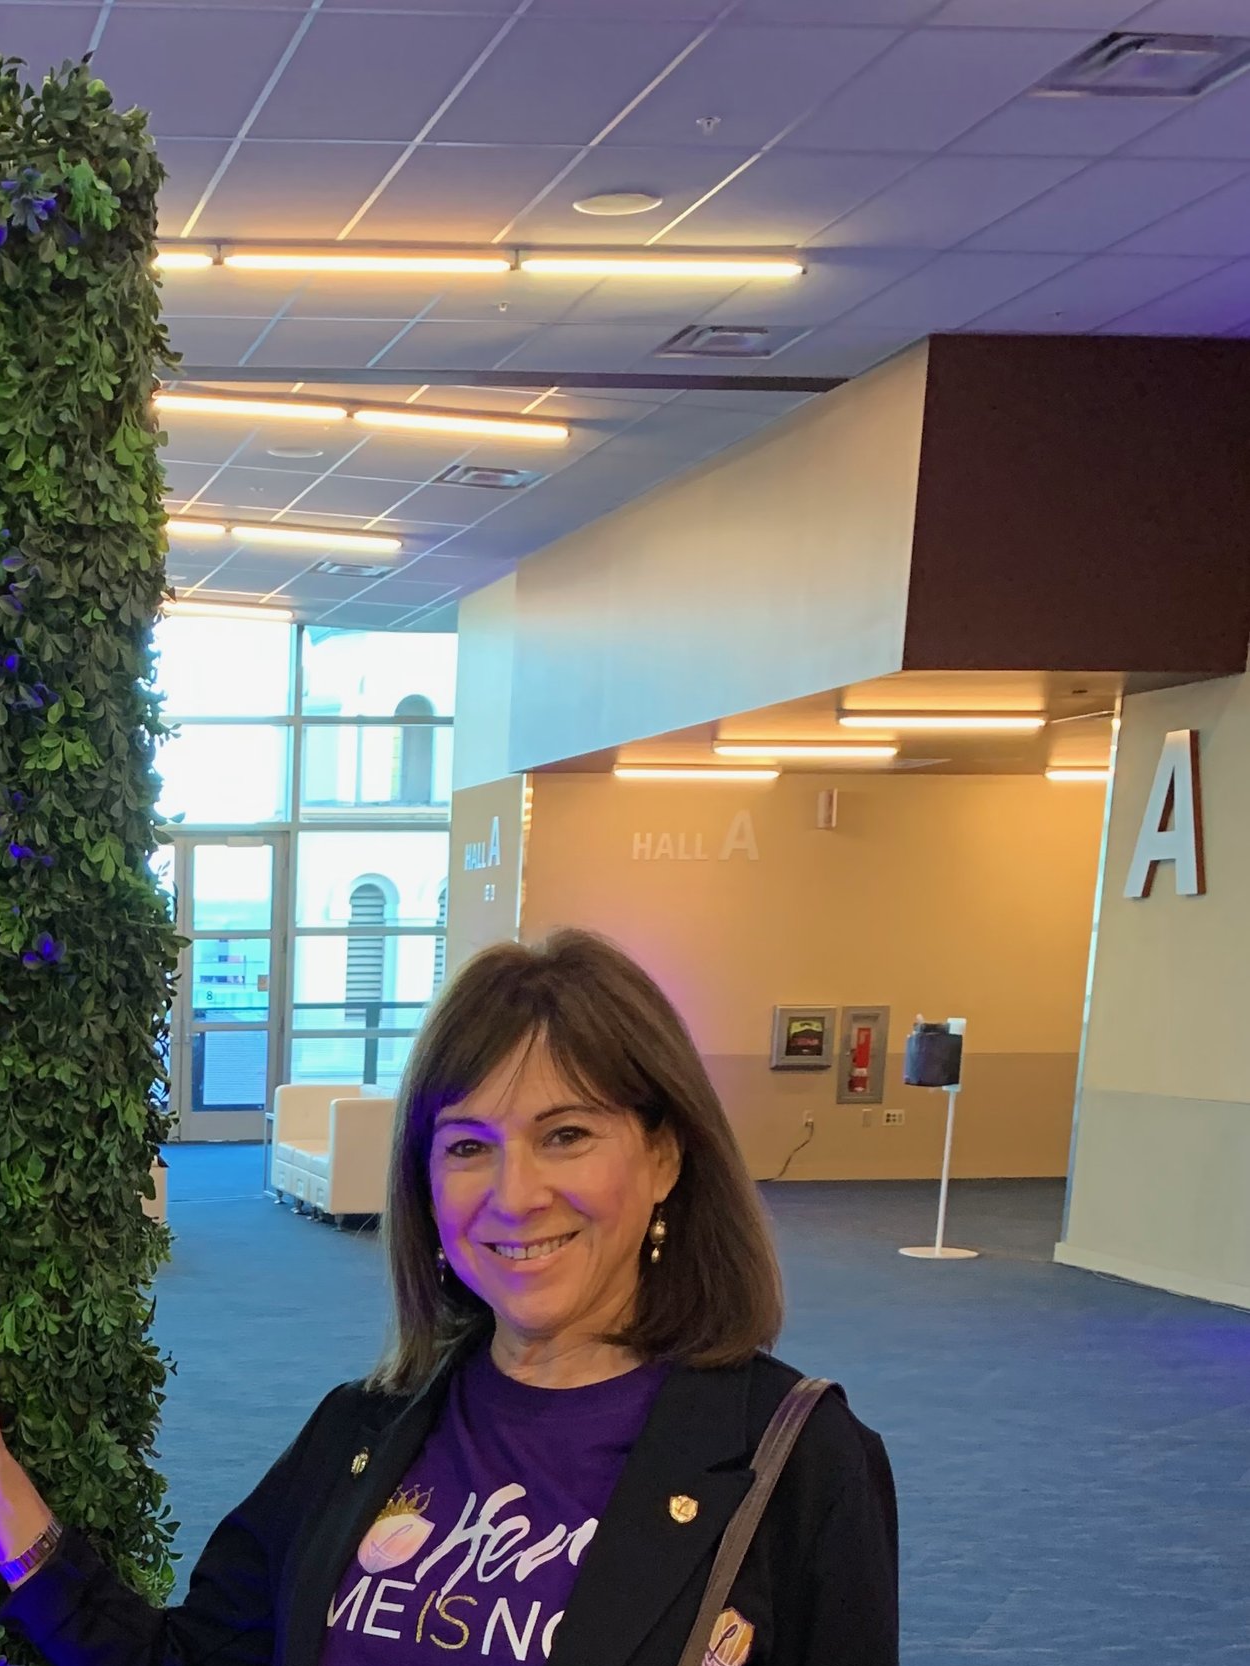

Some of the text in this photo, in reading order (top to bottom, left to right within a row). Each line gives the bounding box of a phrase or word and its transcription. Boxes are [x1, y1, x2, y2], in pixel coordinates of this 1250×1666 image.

[631, 809, 760, 861] HALL A
[1123, 729, 1206, 898] A
[463, 815, 501, 871] HALL A
[415, 1590, 478, 1650] IS
